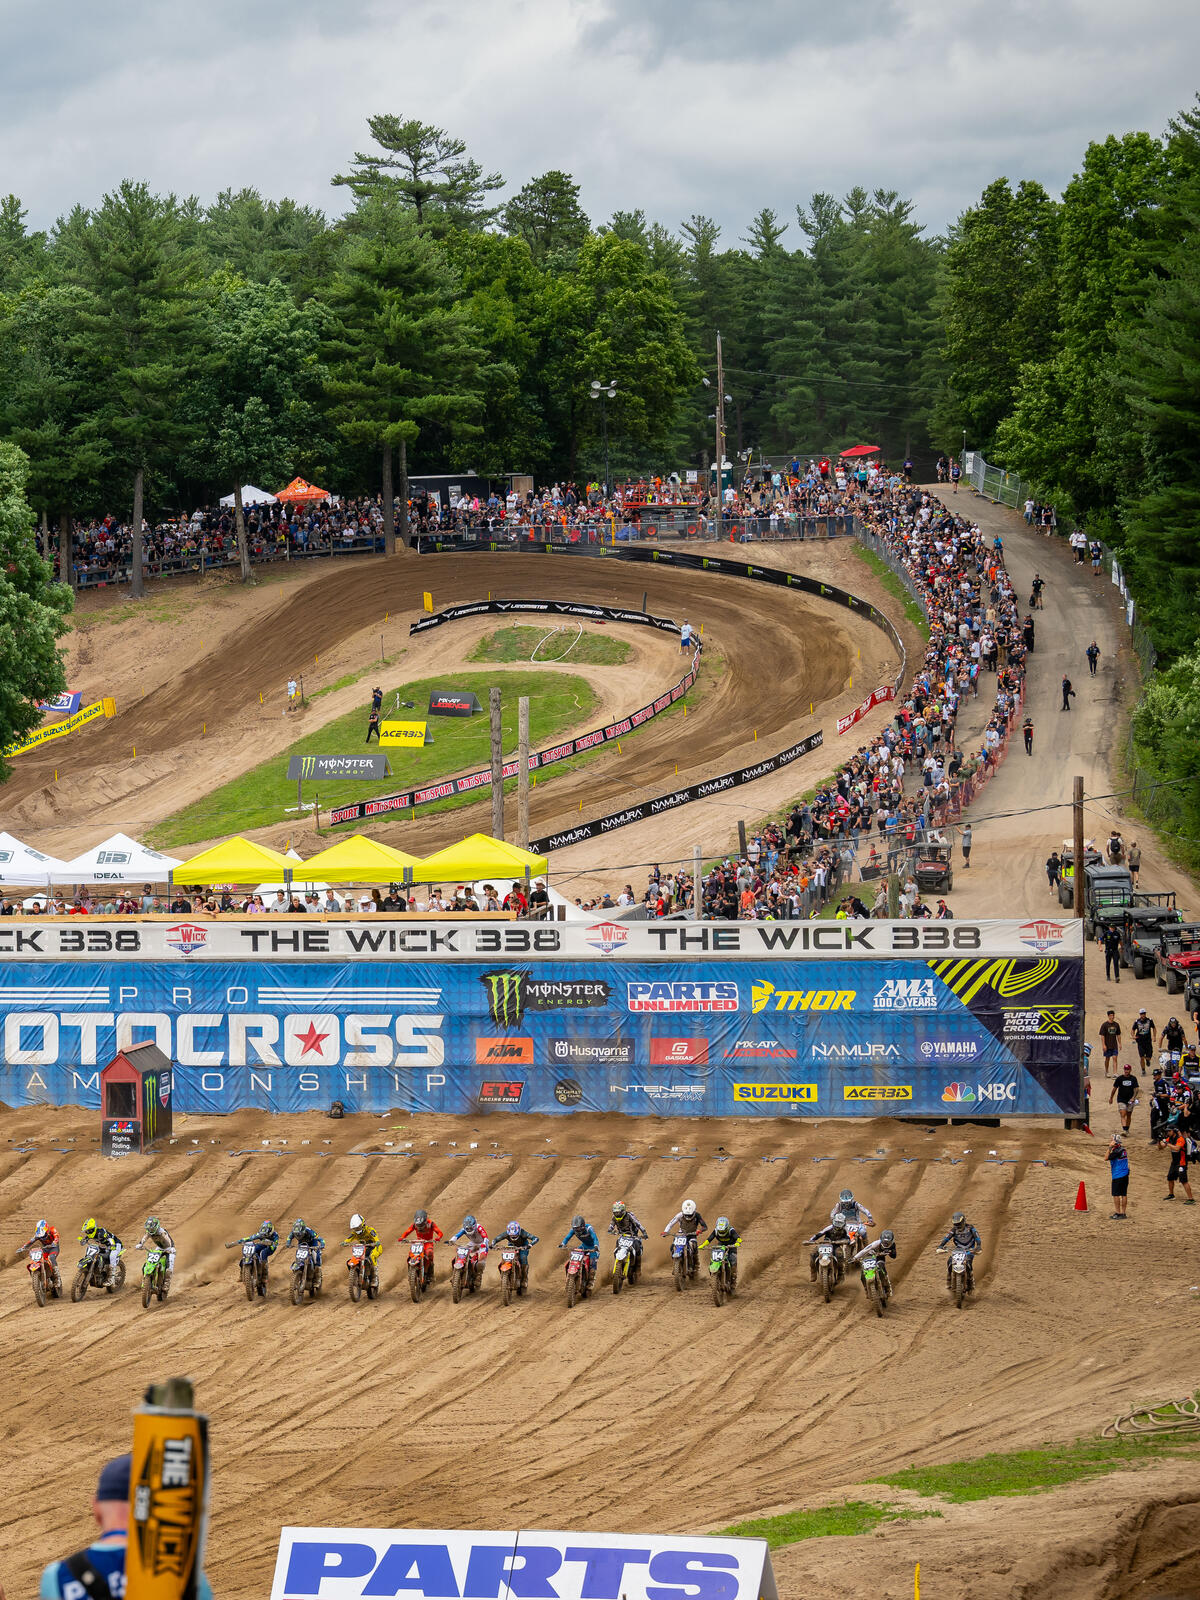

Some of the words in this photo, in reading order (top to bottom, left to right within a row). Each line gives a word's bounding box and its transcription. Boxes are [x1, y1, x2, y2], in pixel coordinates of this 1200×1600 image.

[319, 758, 374, 768] MONSTER
[59, 930, 142, 952] 338
[241, 930, 330, 952] THE
[346, 929, 460, 952] WICK
[475, 929, 560, 952] 338
[648, 928, 741, 951] THE
[757, 927, 875, 950] WICK
[892, 926, 981, 949] 338
[120, 986, 248, 1005] PRO
[526, 983, 606, 997] MONSTER
[628, 982, 738, 999] PARTS
[873, 979, 936, 997] AMA
[628, 1000, 739, 1012] UNLIMITED
[774, 989, 855, 1011] THOR
[873, 997, 893, 1008] 100
[906, 997, 937, 1007] YEARS
[487, 1044, 524, 1057] KTM
[569, 1045, 629, 1060] Husqvarna
[812, 1042, 899, 1056] NAMURA
[933, 1042, 978, 1053] YAMAHA
[482, 1082, 523, 1096] ETS
[609, 1085, 706, 1093] INTENSE
[738, 1086, 812, 1099] SUZUKI
[846, 1087, 910, 1099] ACERBIS
[977, 1083, 1017, 1101] NBC
[161, 1435, 192, 1487] THE
[153, 1486, 194, 1578] WICK
[284, 1541, 740, 1600] PARTS
